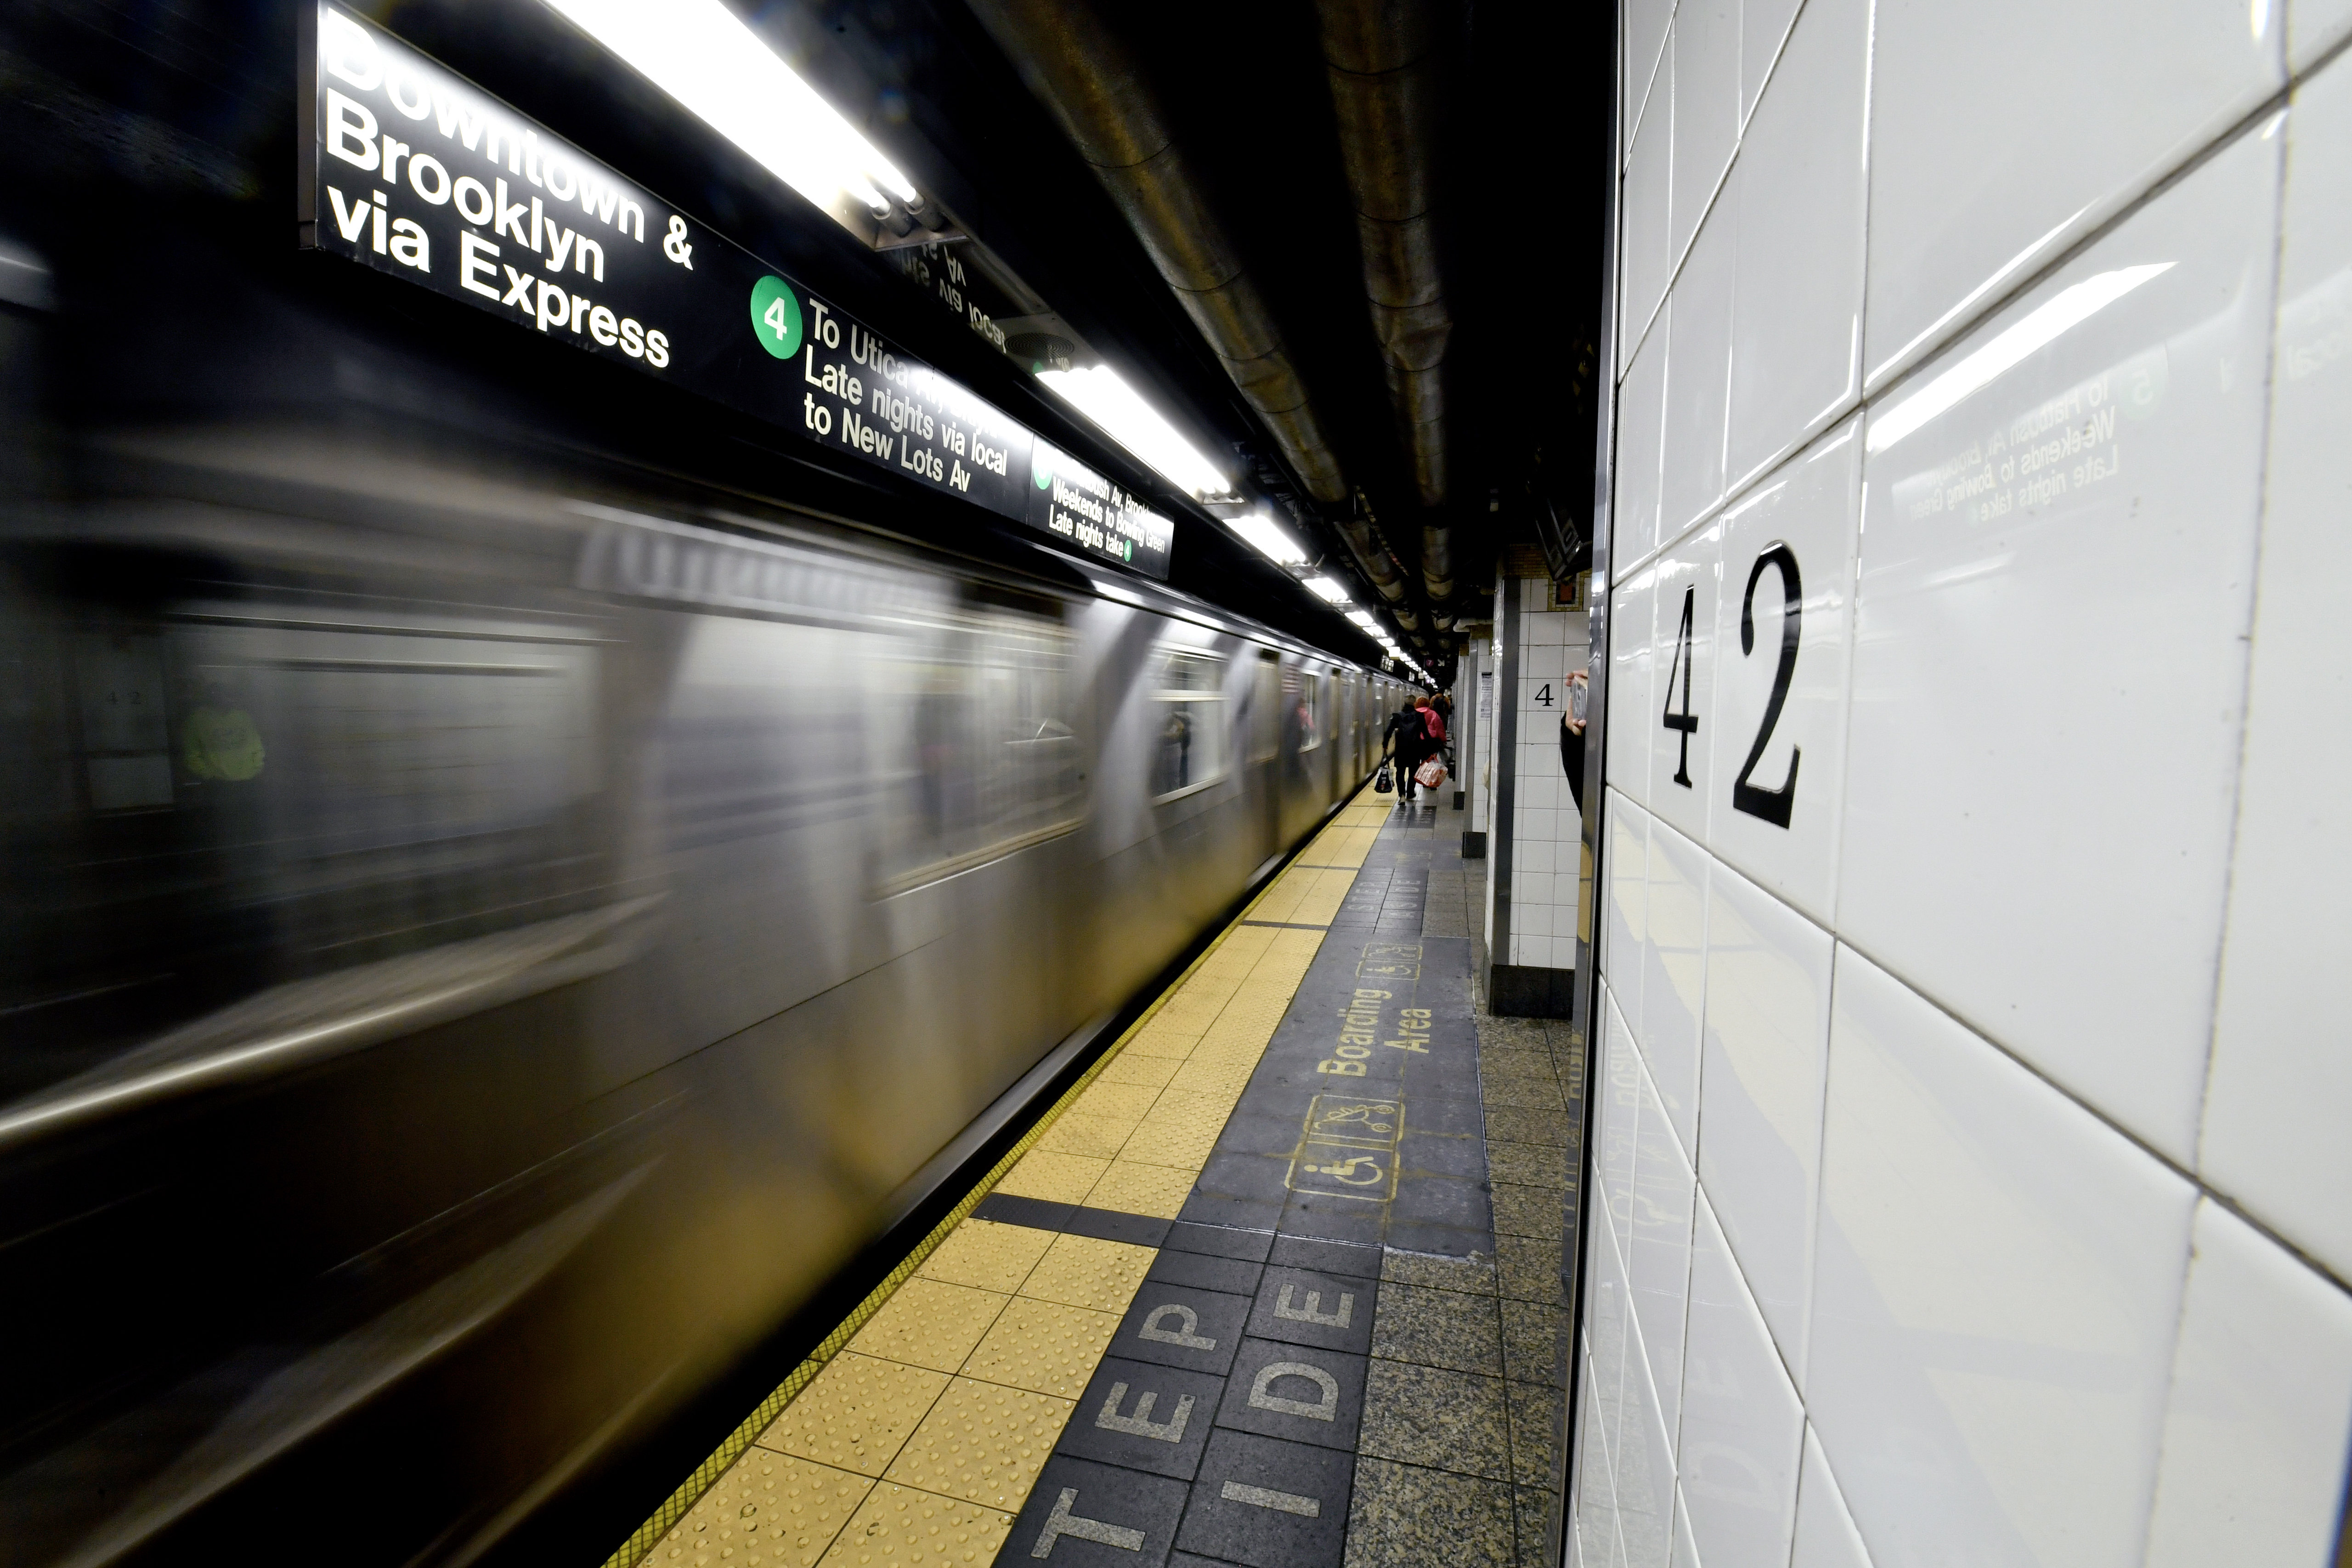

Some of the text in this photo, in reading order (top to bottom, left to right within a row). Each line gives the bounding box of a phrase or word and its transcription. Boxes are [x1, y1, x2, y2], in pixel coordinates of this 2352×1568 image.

[327, 6, 693, 271] Downtown &
[327, 87, 604, 283] Brooklyn
[327, 185, 670, 368] via Express
[763, 296, 787, 340] 4
[809, 297, 840, 349] To
[850, 324, 909, 387] Utica
[803, 392, 971, 492] to New Lots Av
[804, 344, 863, 405] Late
[872, 387, 934, 441] nights
[941, 421, 965, 456] via
[971, 432, 1007, 476] local
[1049, 504, 1073, 536] Late
[1075, 519, 1103, 548] nights
[1106, 532, 1124, 557] take
[1053, 475, 1165, 554] Weekends to Bowling Green
[1111, 486, 1123, 512] Av,
[1534, 683, 1555, 707] 4
[1317, 988, 1393, 1077] Boarding
[1383, 1008, 1432, 1054] Area
